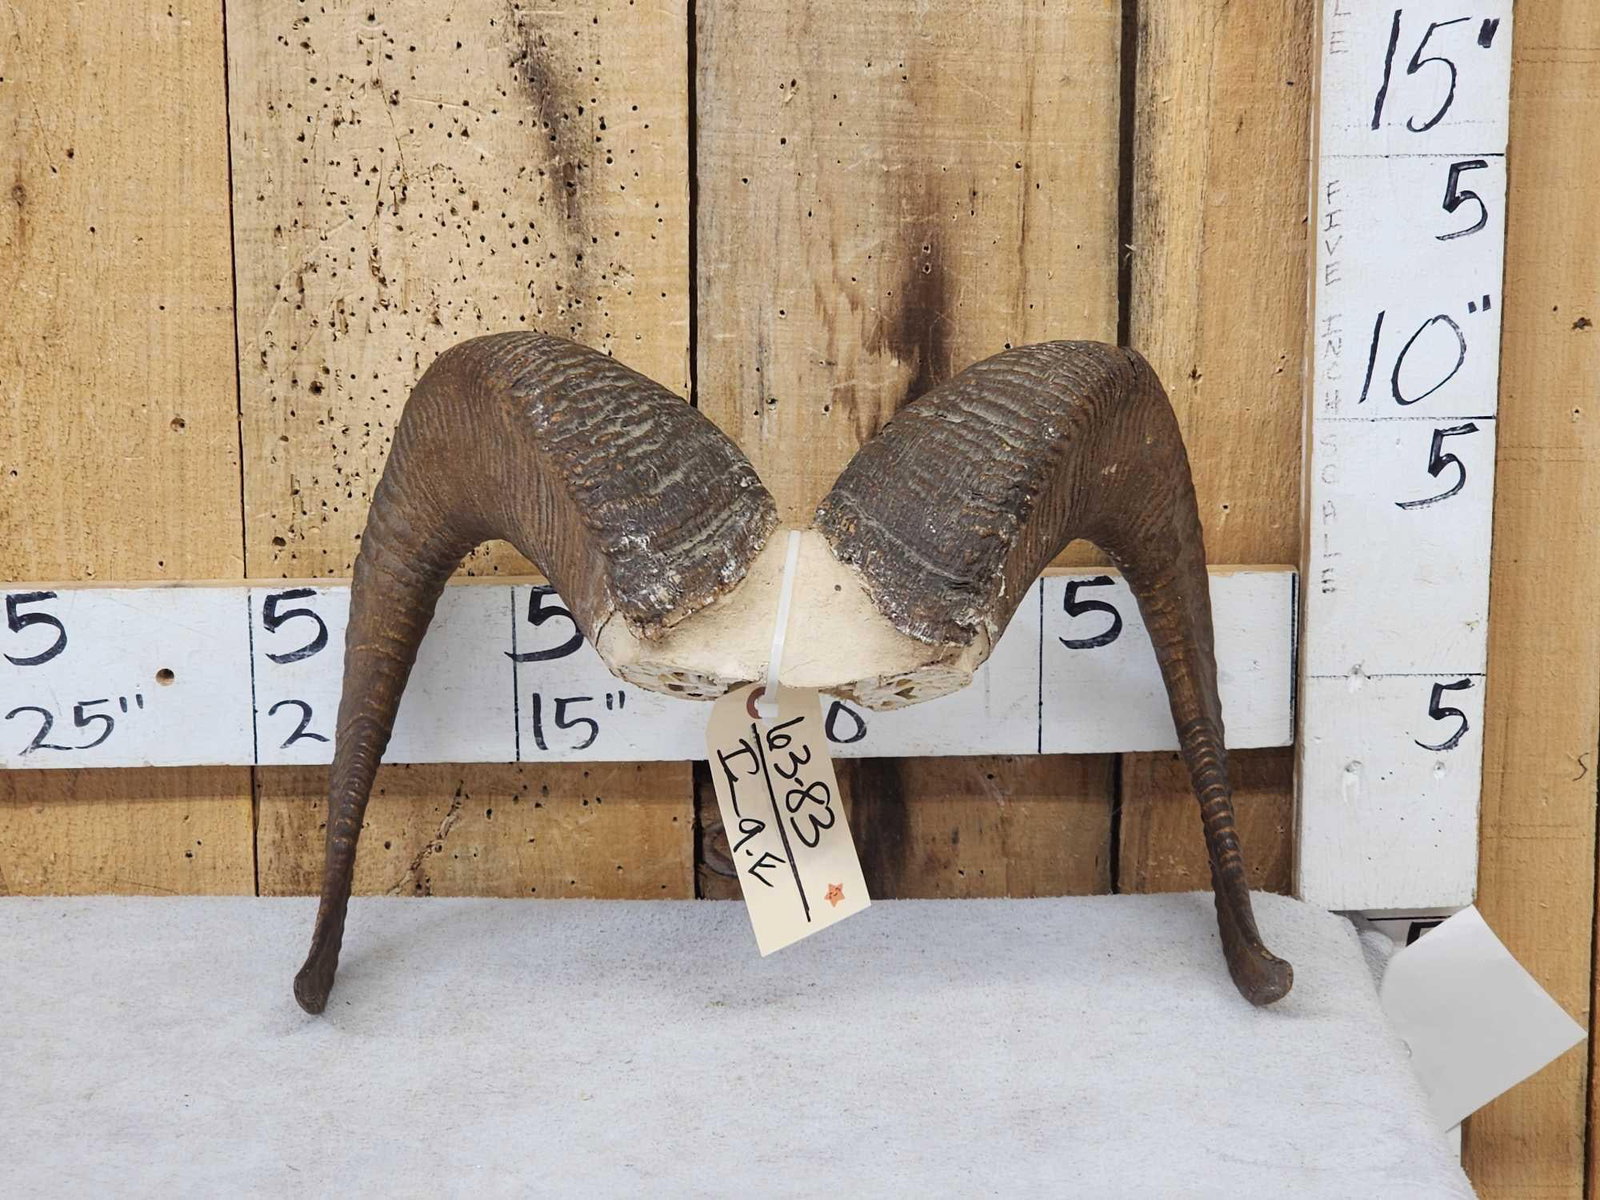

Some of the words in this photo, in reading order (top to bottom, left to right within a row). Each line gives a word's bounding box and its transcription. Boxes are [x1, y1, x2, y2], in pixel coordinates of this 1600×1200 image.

[1371, 9, 1500, 132] 15"
[1435, 159, 1488, 241] 5
[1358, 294, 1492, 406] 10"
[1394, 422, 1480, 510] 5
[3, 590, 68, 666] 5
[263, 587, 329, 665] 5
[504, 585, 585, 663] 5
[1058, 575, 1123, 650] 5
[5, 693, 144, 756] 25"
[532, 690, 626, 751] 15"
[1414, 677, 1476, 751] 5
